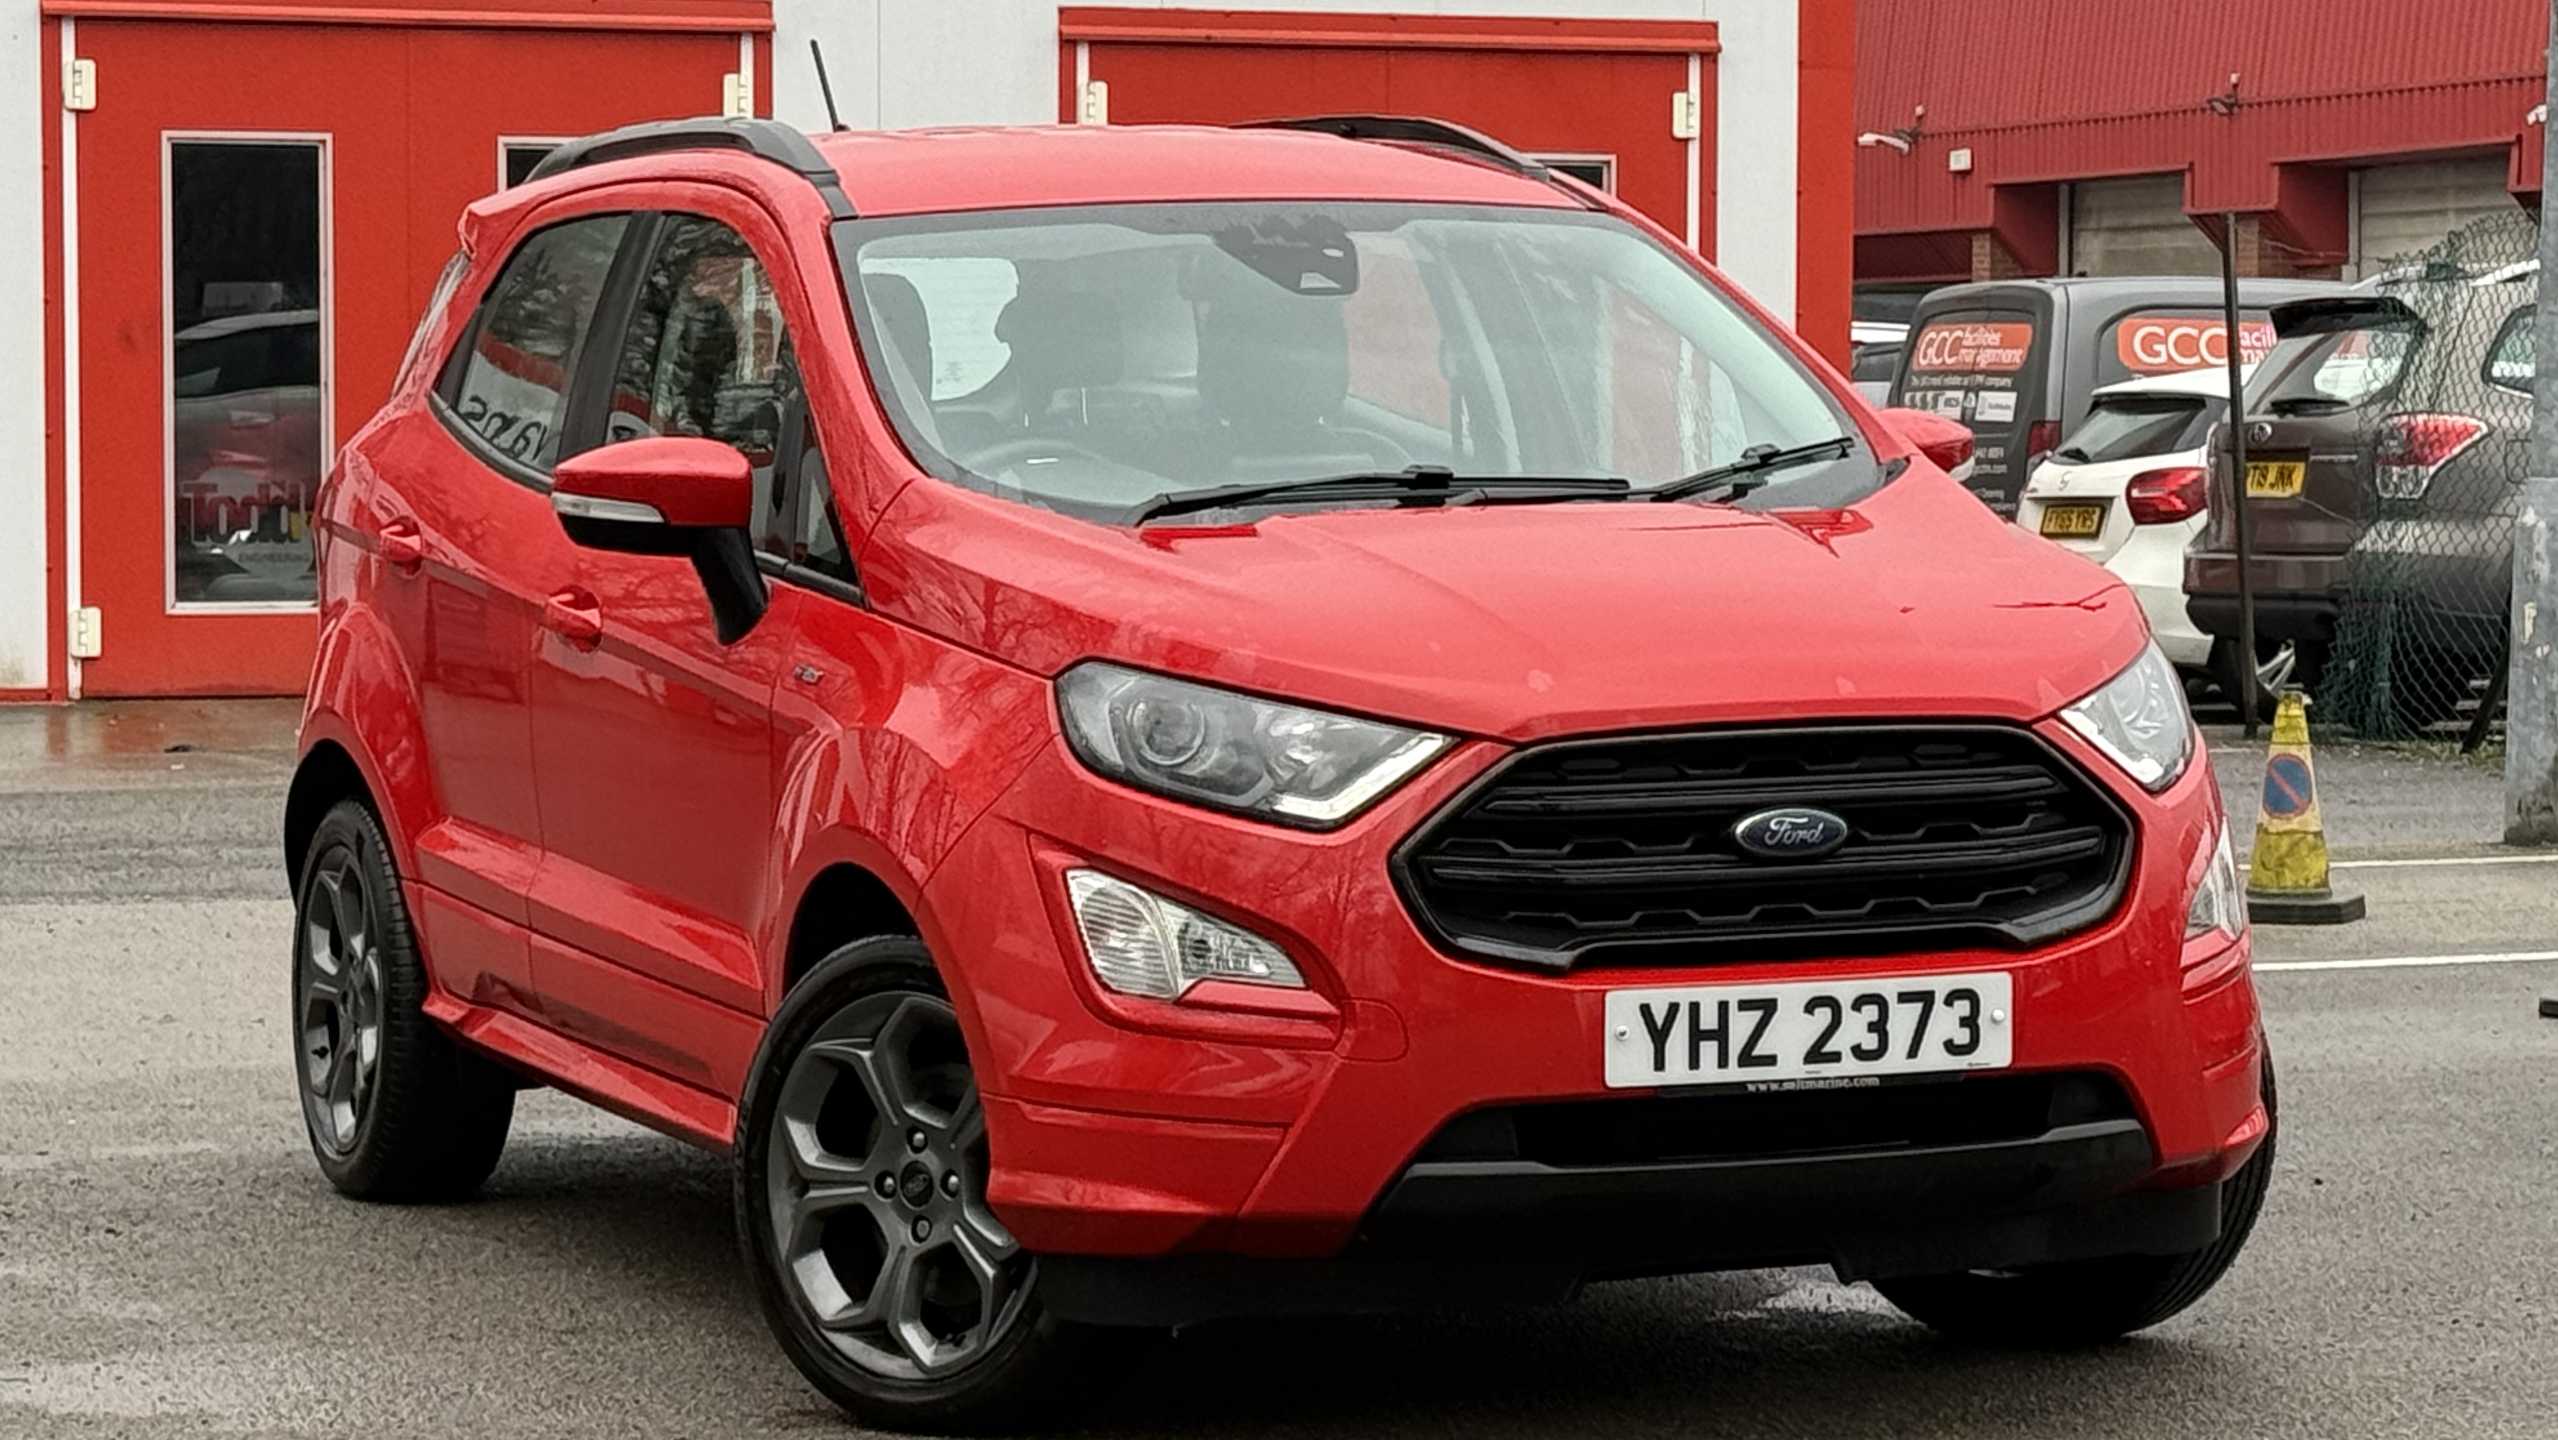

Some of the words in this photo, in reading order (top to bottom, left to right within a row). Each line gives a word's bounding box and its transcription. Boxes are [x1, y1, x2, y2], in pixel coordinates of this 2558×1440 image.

[1919, 328, 1964, 365] GCC
[2133, 324, 2228, 366] GCC
[1763, 816, 1825, 846] Ford
[1639, 997, 1779, 1072] YHZ
[1802, 987, 1982, 1066] 2373
